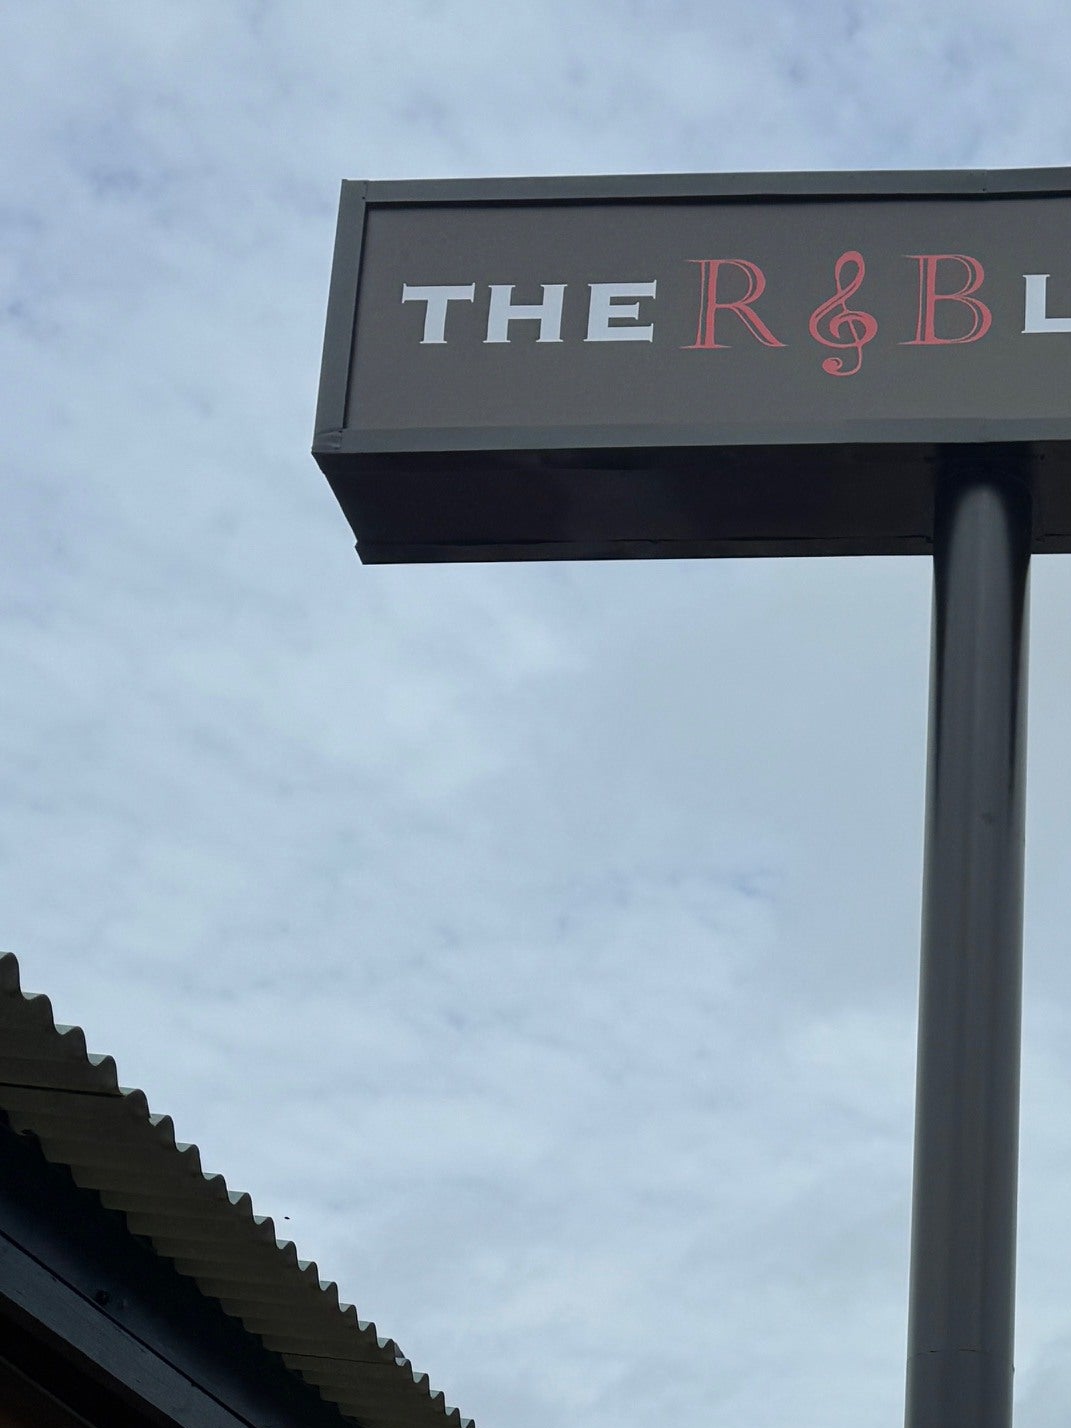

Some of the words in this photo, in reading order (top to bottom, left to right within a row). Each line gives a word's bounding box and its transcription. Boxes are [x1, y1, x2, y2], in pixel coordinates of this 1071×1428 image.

[401, 279, 657, 344] THE
[680, 258, 788, 350] R
[897, 254, 993, 346] B
